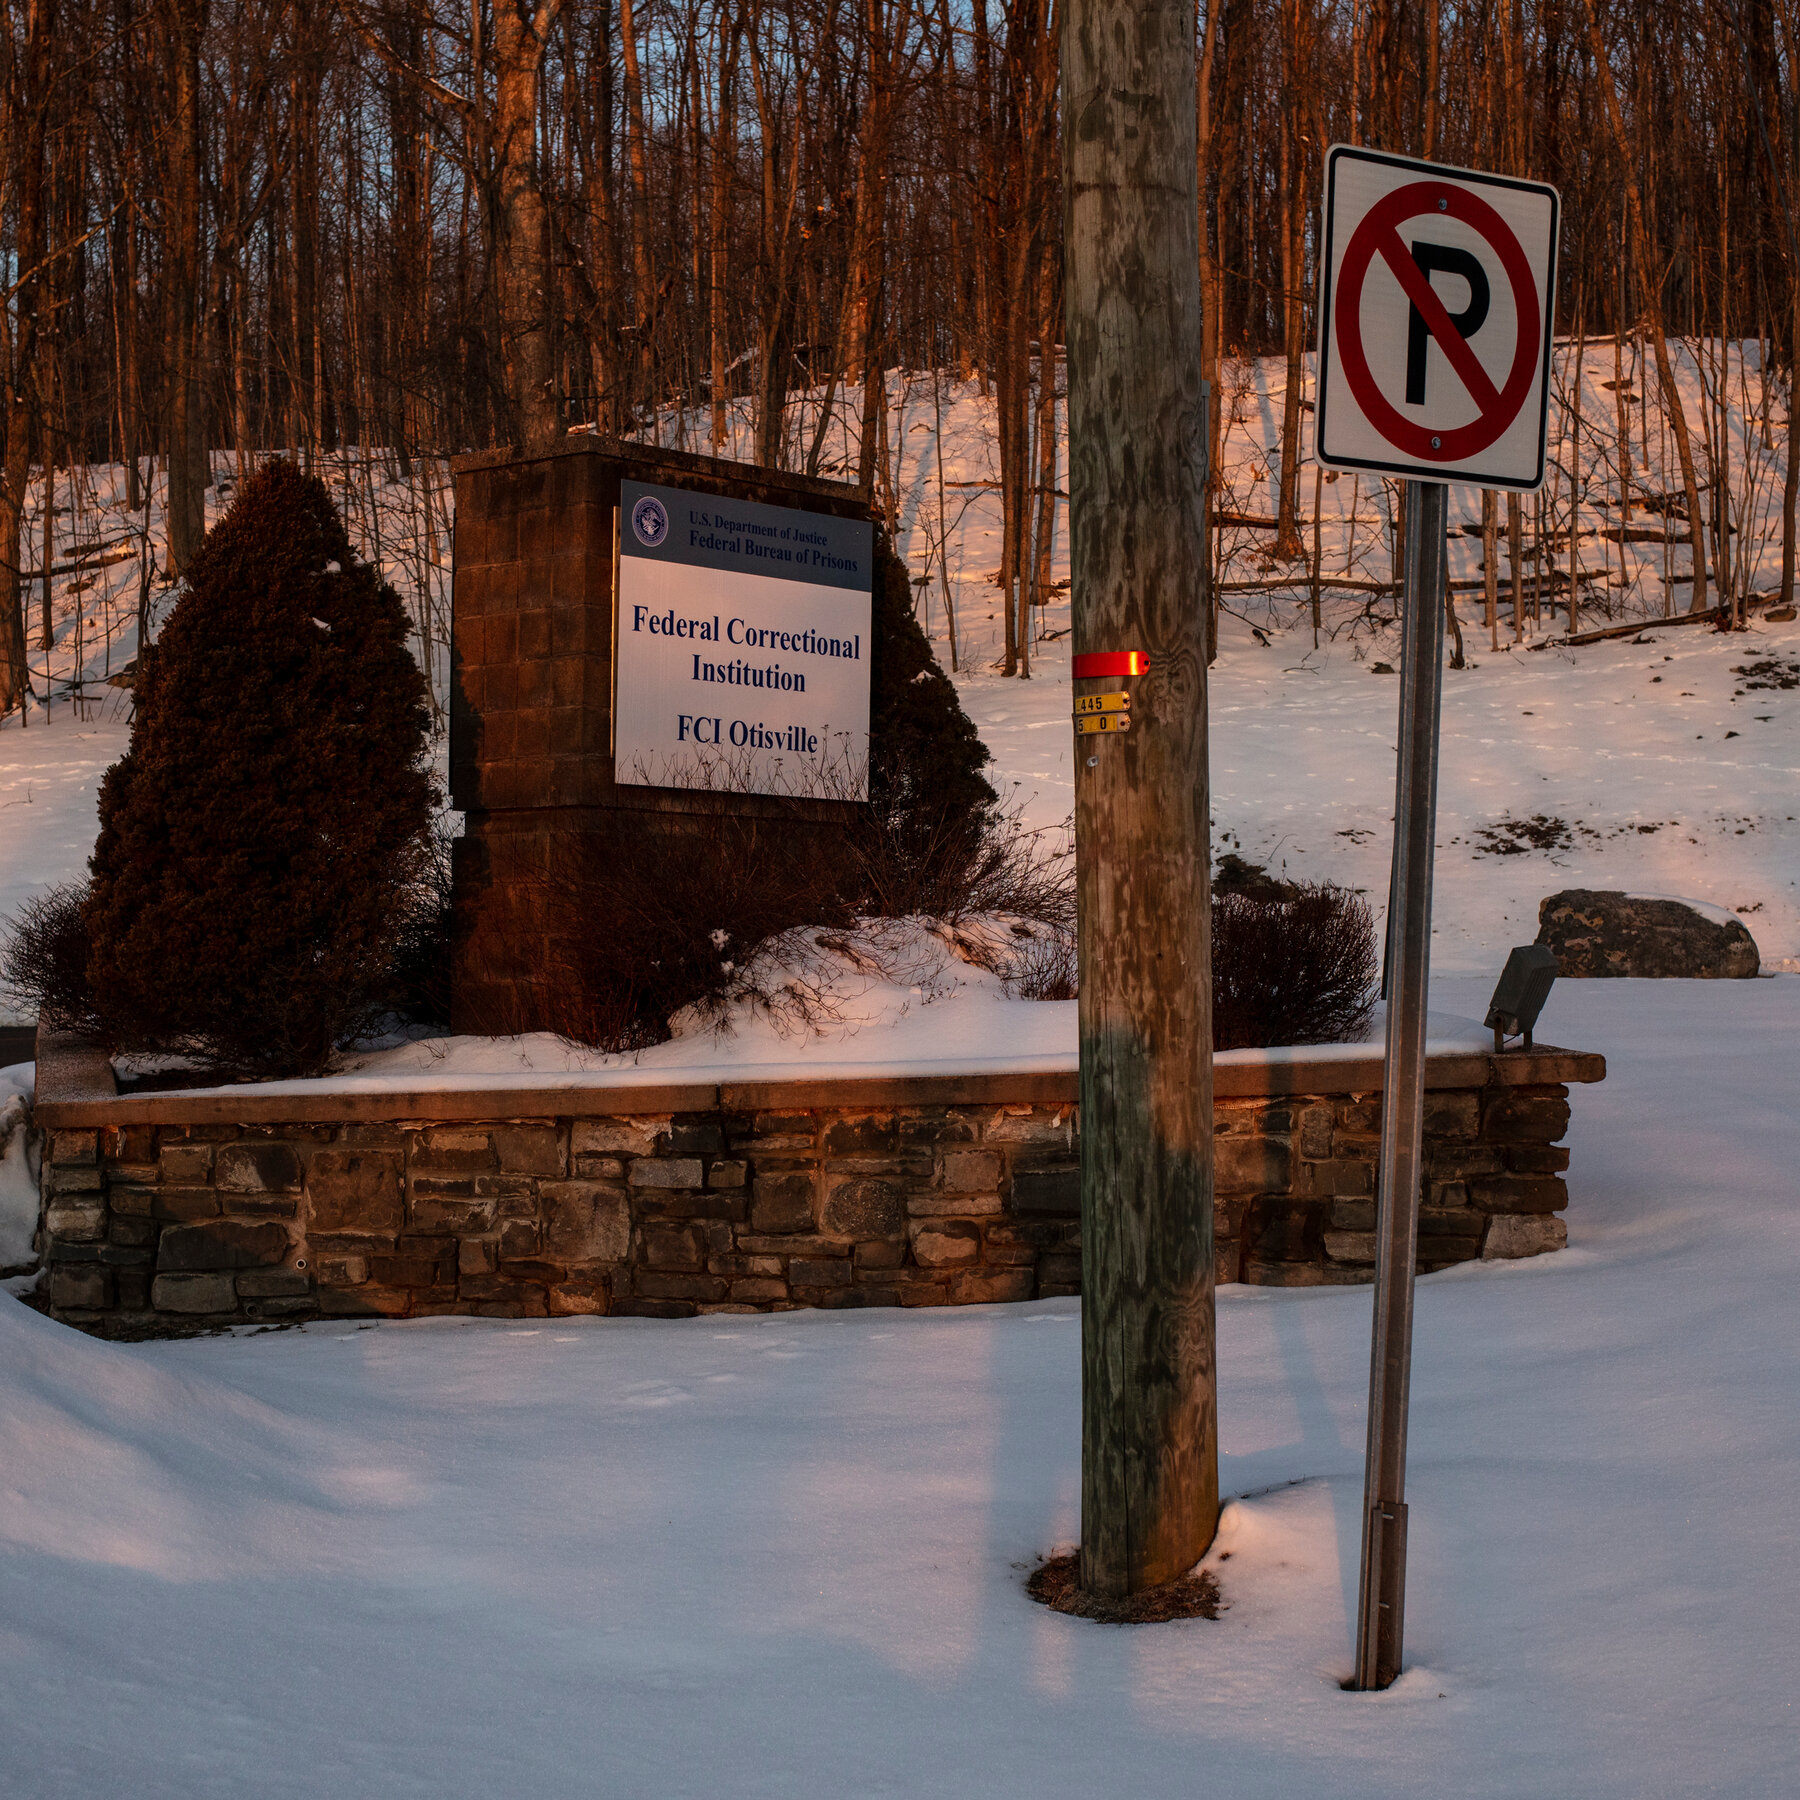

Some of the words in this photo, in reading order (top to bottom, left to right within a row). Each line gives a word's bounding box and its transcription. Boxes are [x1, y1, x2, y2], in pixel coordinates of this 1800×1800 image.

[689, 510, 712, 527] U.S.
[715, 514, 778, 538] Department
[780, 527, 792, 540] of
[792, 529, 828, 546] Justice
[689, 529, 741, 553] Federal
[745, 538, 792, 562] Bureau
[796, 548, 810, 564] of
[812, 550, 858, 572] Prisons
[632, 604, 720, 642] Federal
[727, 617, 860, 660] Correctional
[691, 653, 806, 692] Institution
[677, 714, 723, 744] FCI
[729, 719, 818, 753] Otisville
